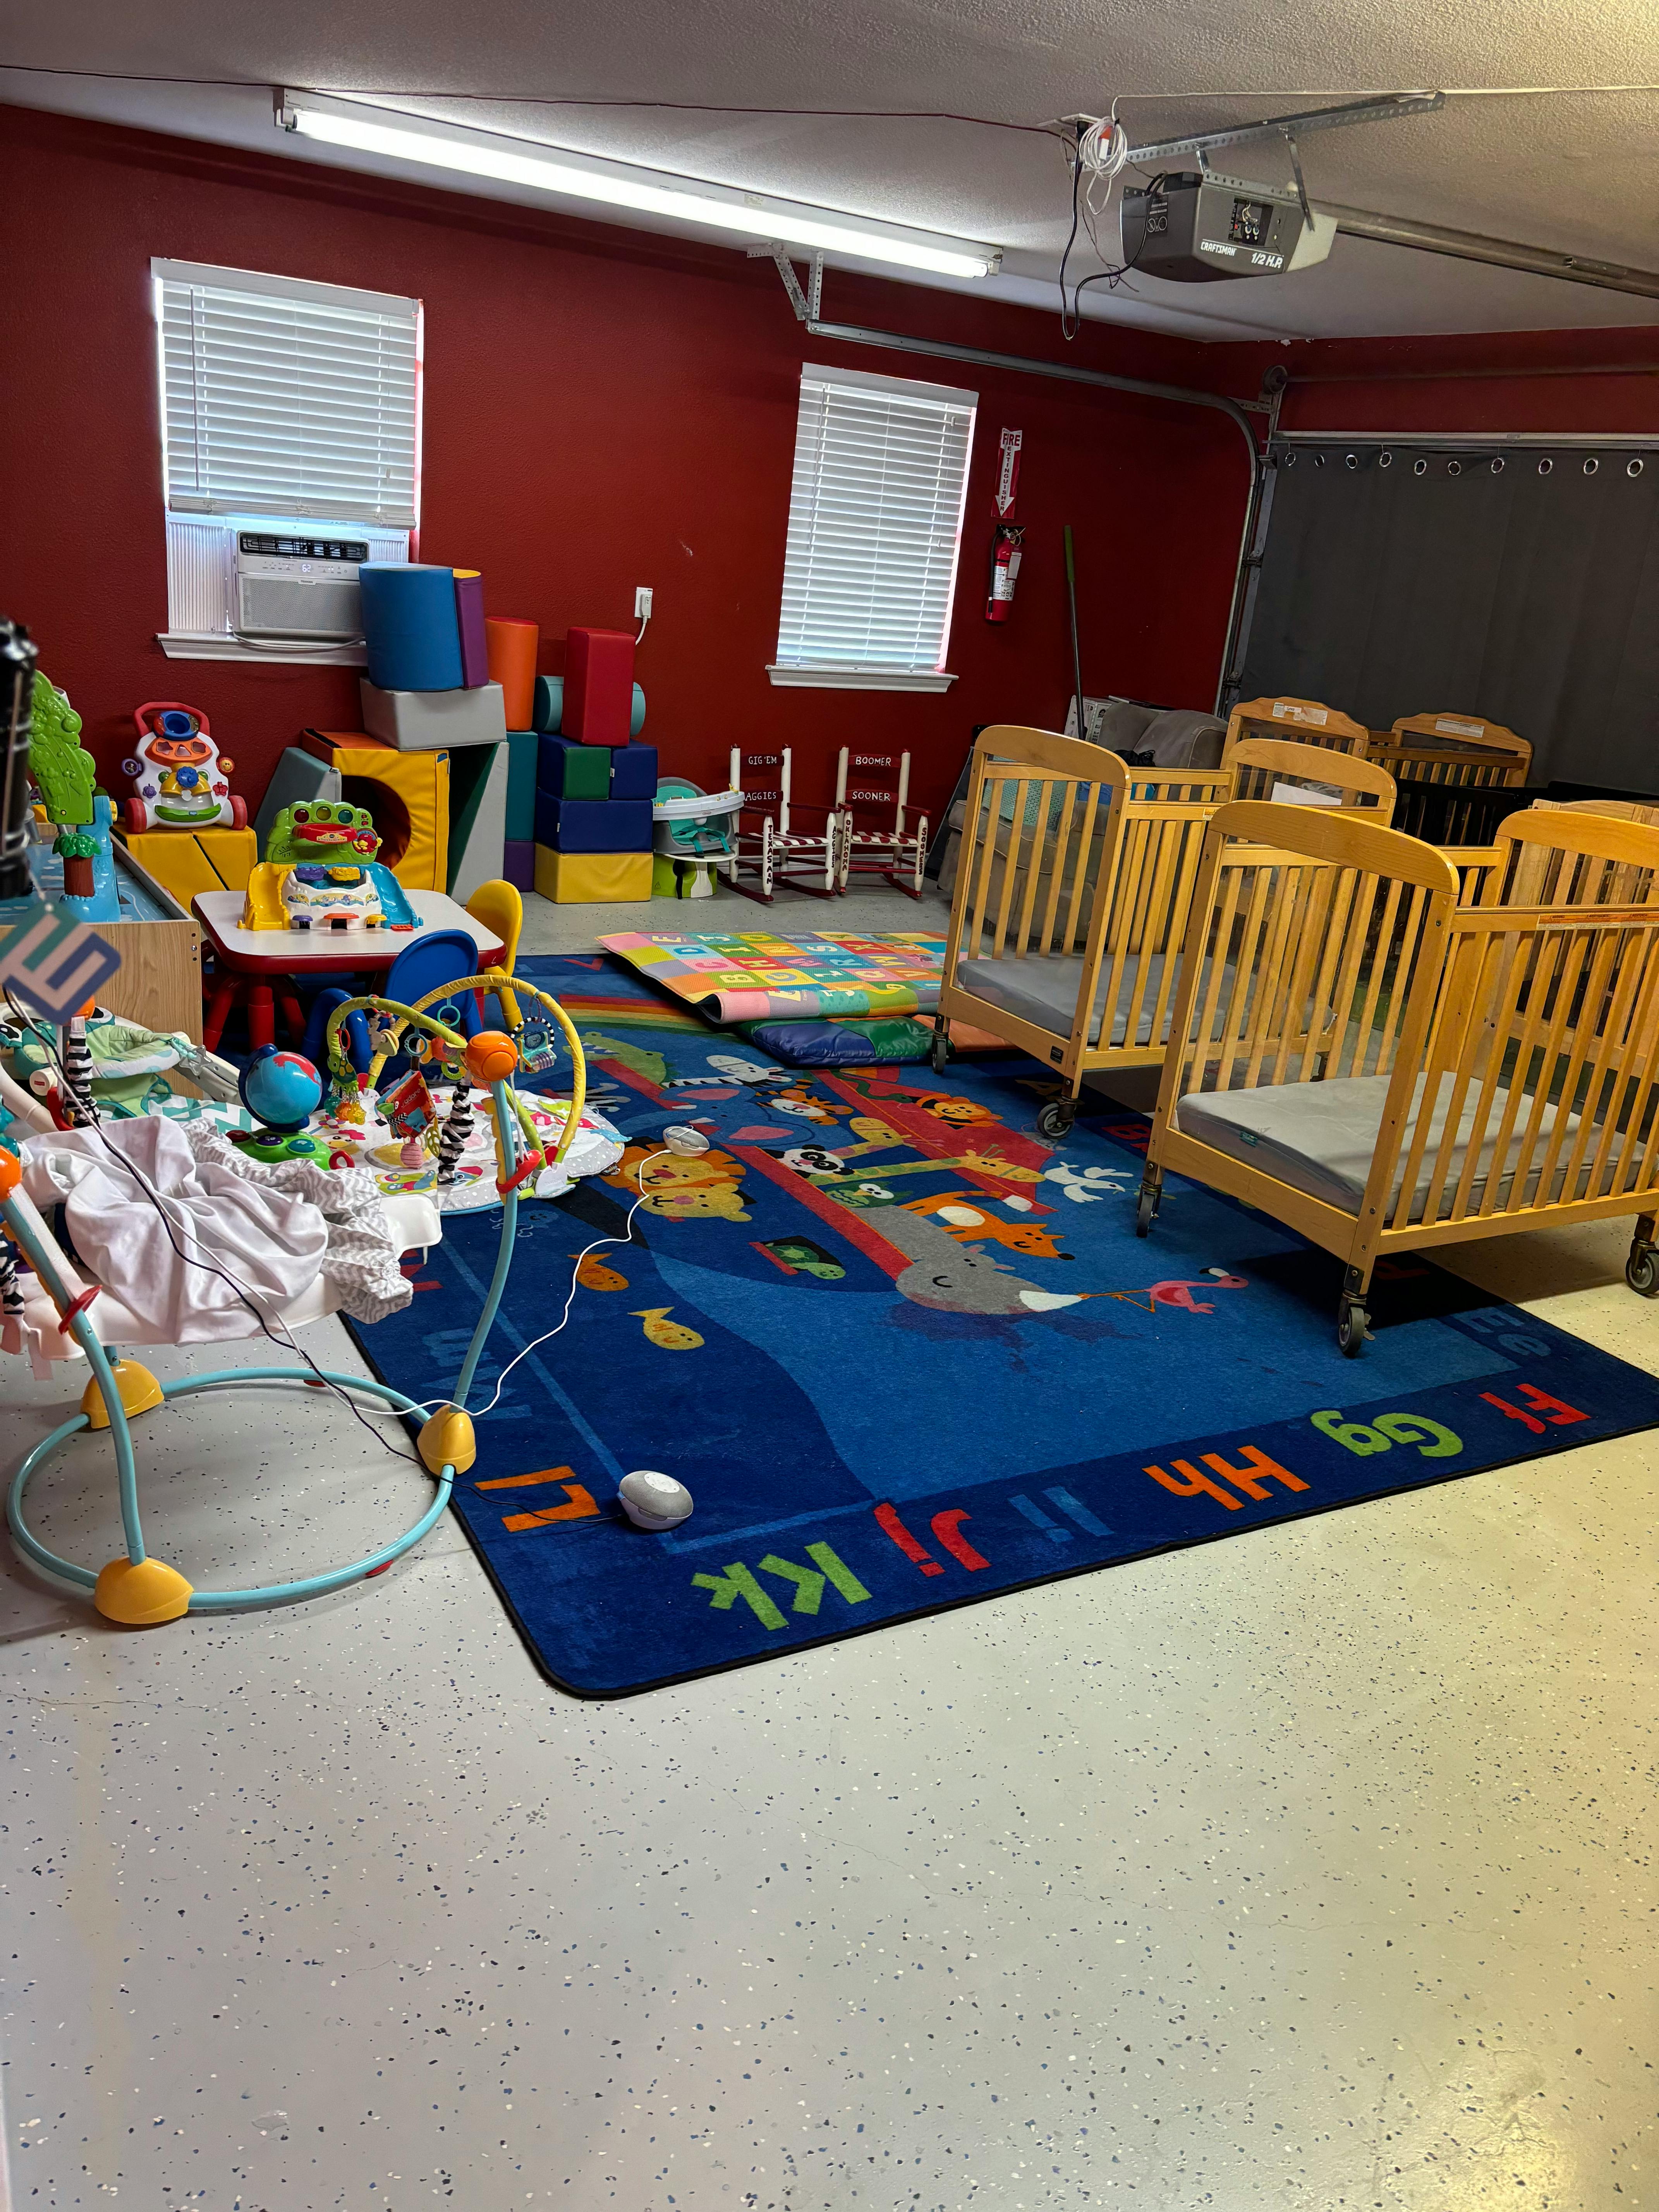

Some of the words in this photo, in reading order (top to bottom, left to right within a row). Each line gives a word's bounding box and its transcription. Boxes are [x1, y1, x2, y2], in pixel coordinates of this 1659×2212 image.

[1201, 241, 1237, 256] CRAFTSMAN
[1251, 252, 1266, 265] 1/2
[1002, 433, 1020, 446] FIRE
[1000, 447, 1012, 511] EXTINGUISHER
[749, 756, 762, 765] GIG
[856, 756, 891, 766] BOOMER
[745, 792, 776, 801] AGGIES
[852, 791, 891, 802] SOONER
[842, 819, 851, 871] OKLAHOMA
[918, 827, 927, 875] SOONERS
[738, 960, 778, 968] H
[719, 974, 756, 983] B
[1478, 1383, 1591, 1434] Ff
[1310, 1410, 1463, 1458] Gg
[1142, 1444, 1311, 1511] Hh
[873, 1502, 991, 1578] Jj
[690, 1541, 873, 1631] Kk
